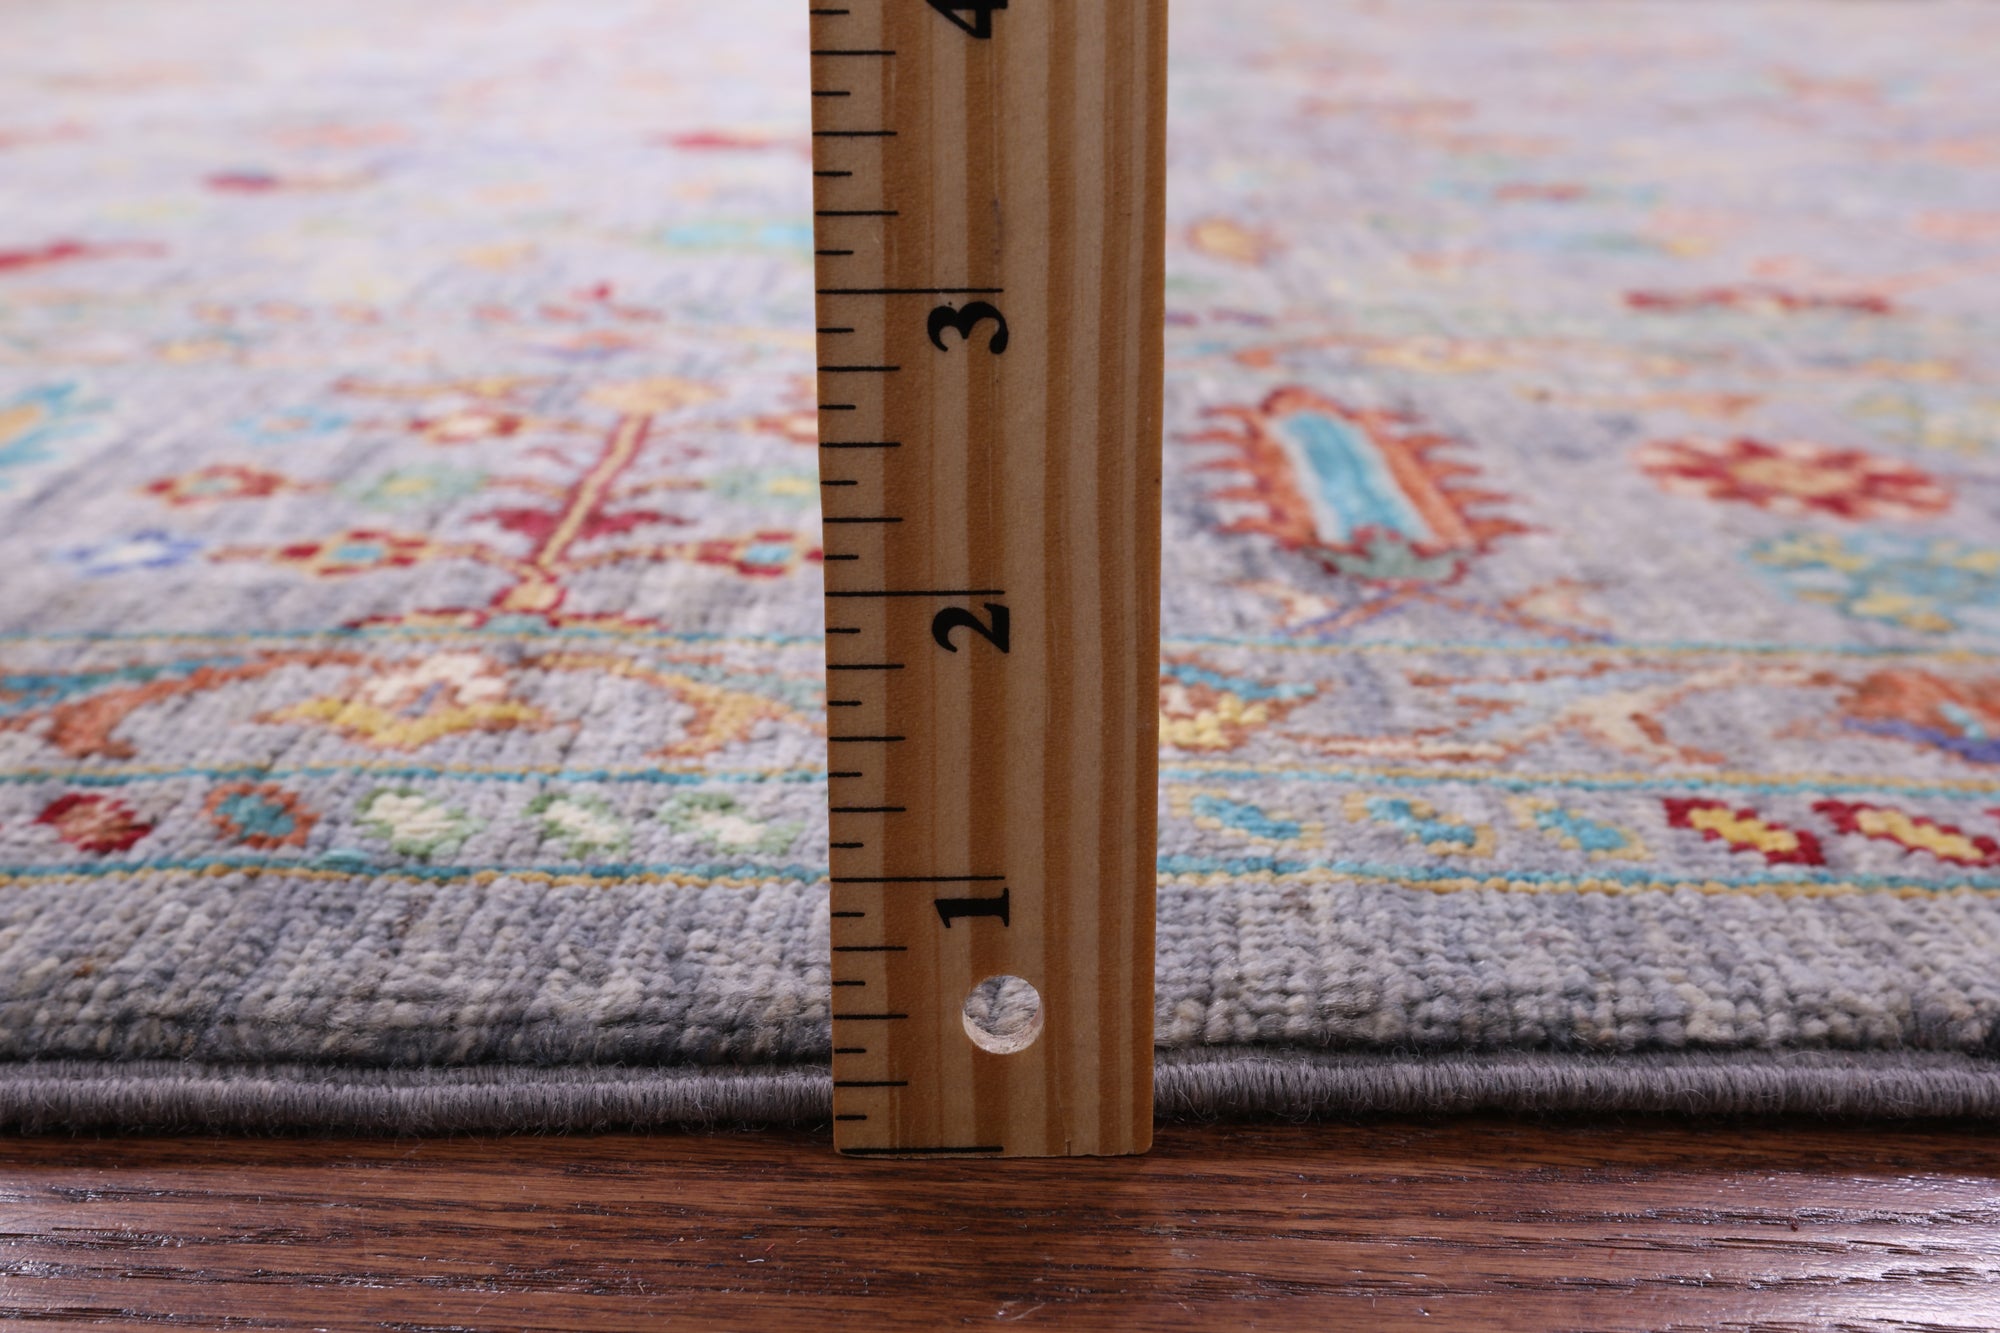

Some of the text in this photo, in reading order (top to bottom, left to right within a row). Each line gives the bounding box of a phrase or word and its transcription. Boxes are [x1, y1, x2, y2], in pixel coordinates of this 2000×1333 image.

[925, 0, 1008, 39] 4
[927, 301, 1008, 355] 3
[931, 602, 1010, 654] 2
[934, 887, 1010, 929] 1
